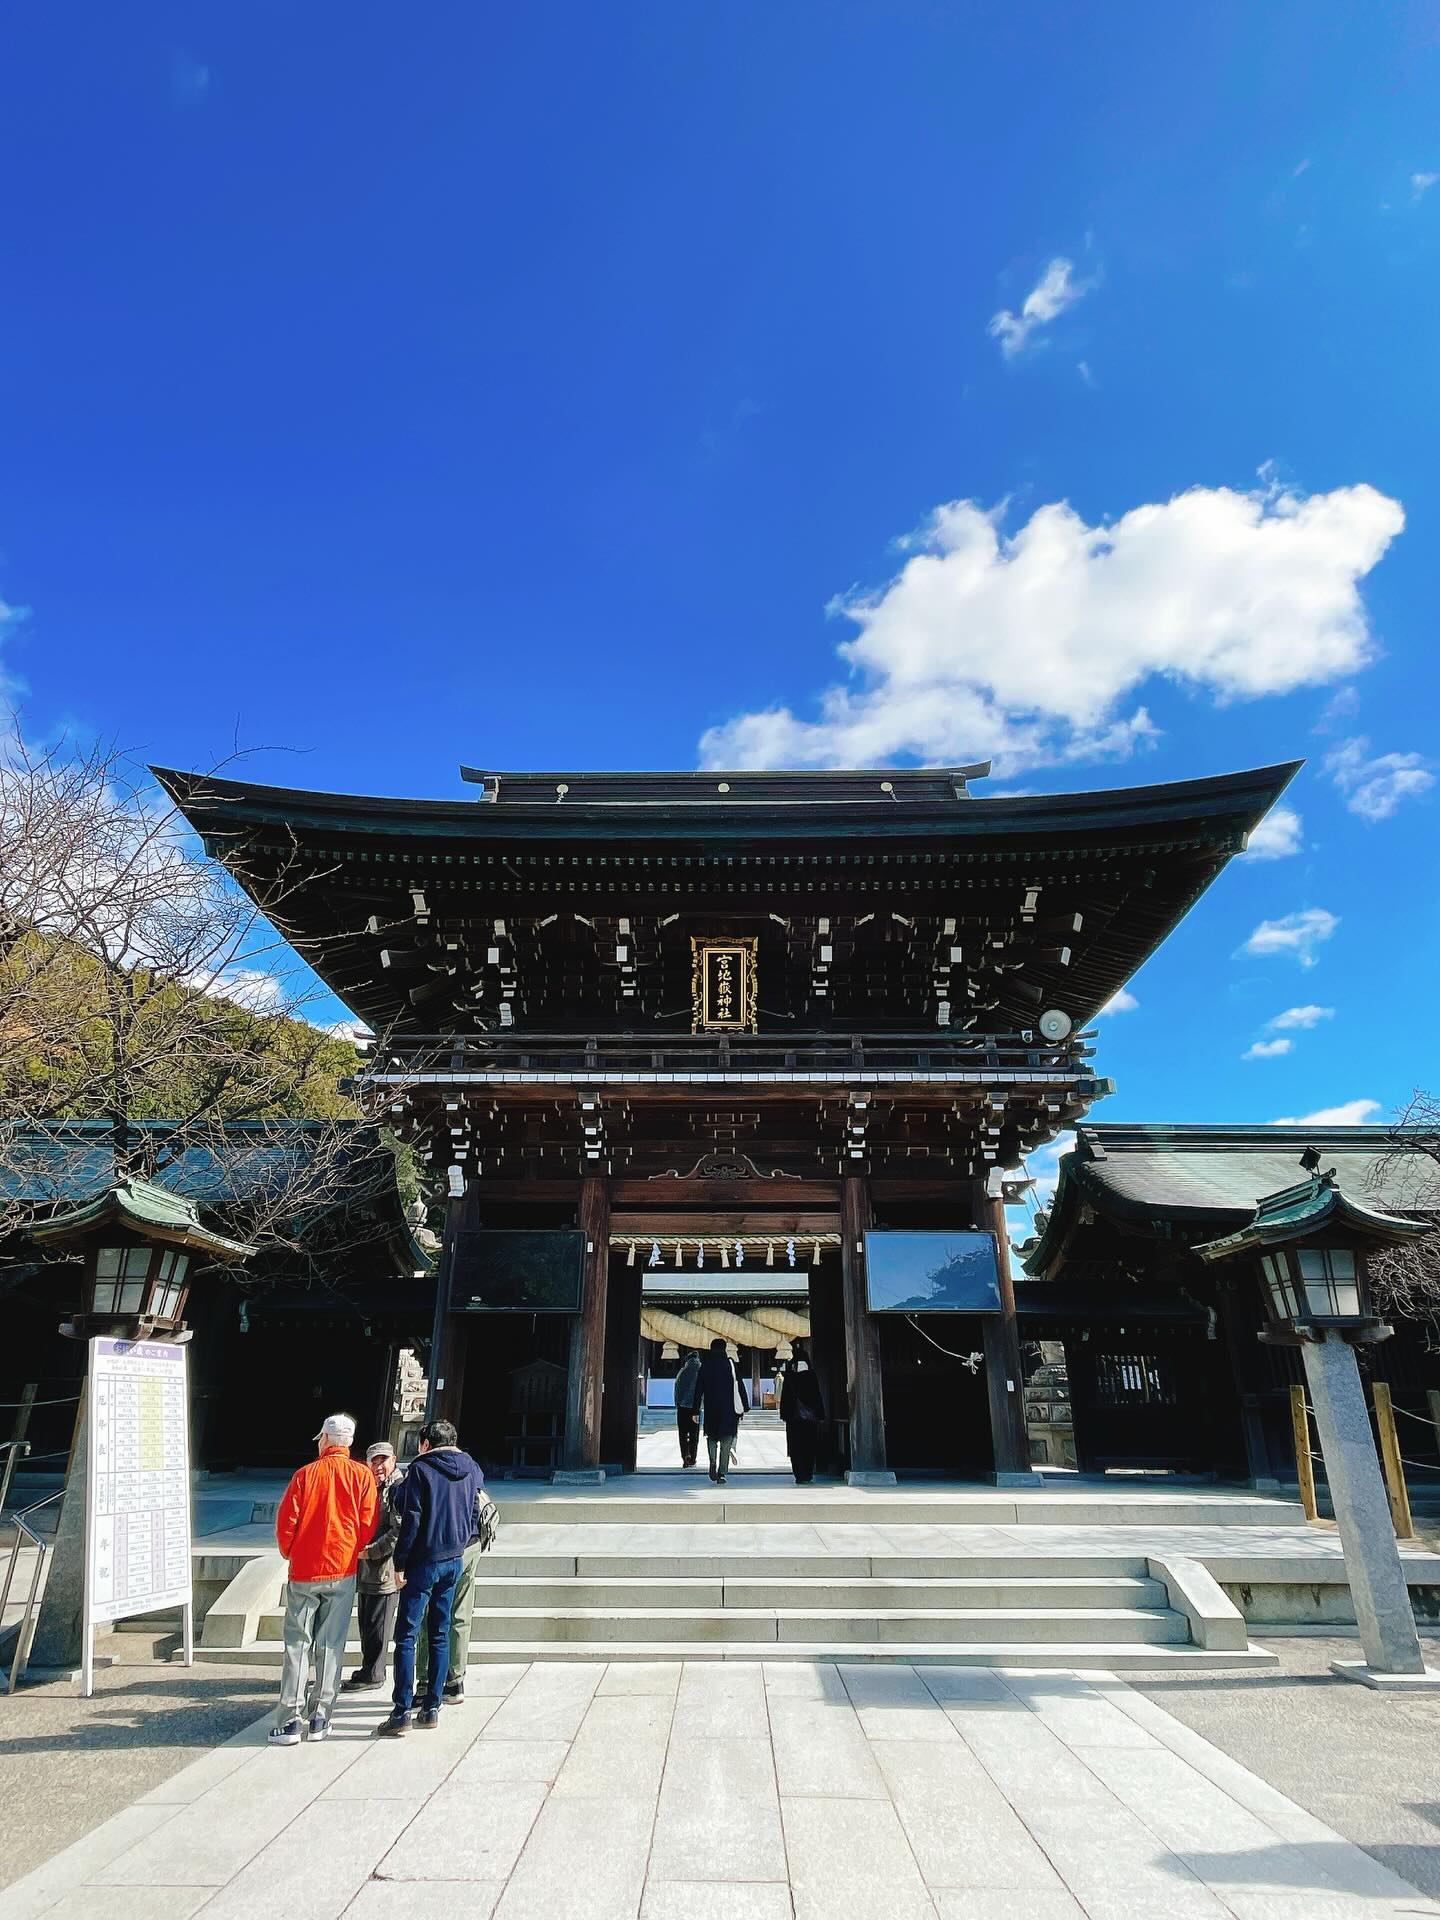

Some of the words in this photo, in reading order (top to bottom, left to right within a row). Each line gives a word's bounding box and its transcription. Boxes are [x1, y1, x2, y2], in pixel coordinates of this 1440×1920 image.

[716, 954, 733, 1019] 宮地嶽神社
